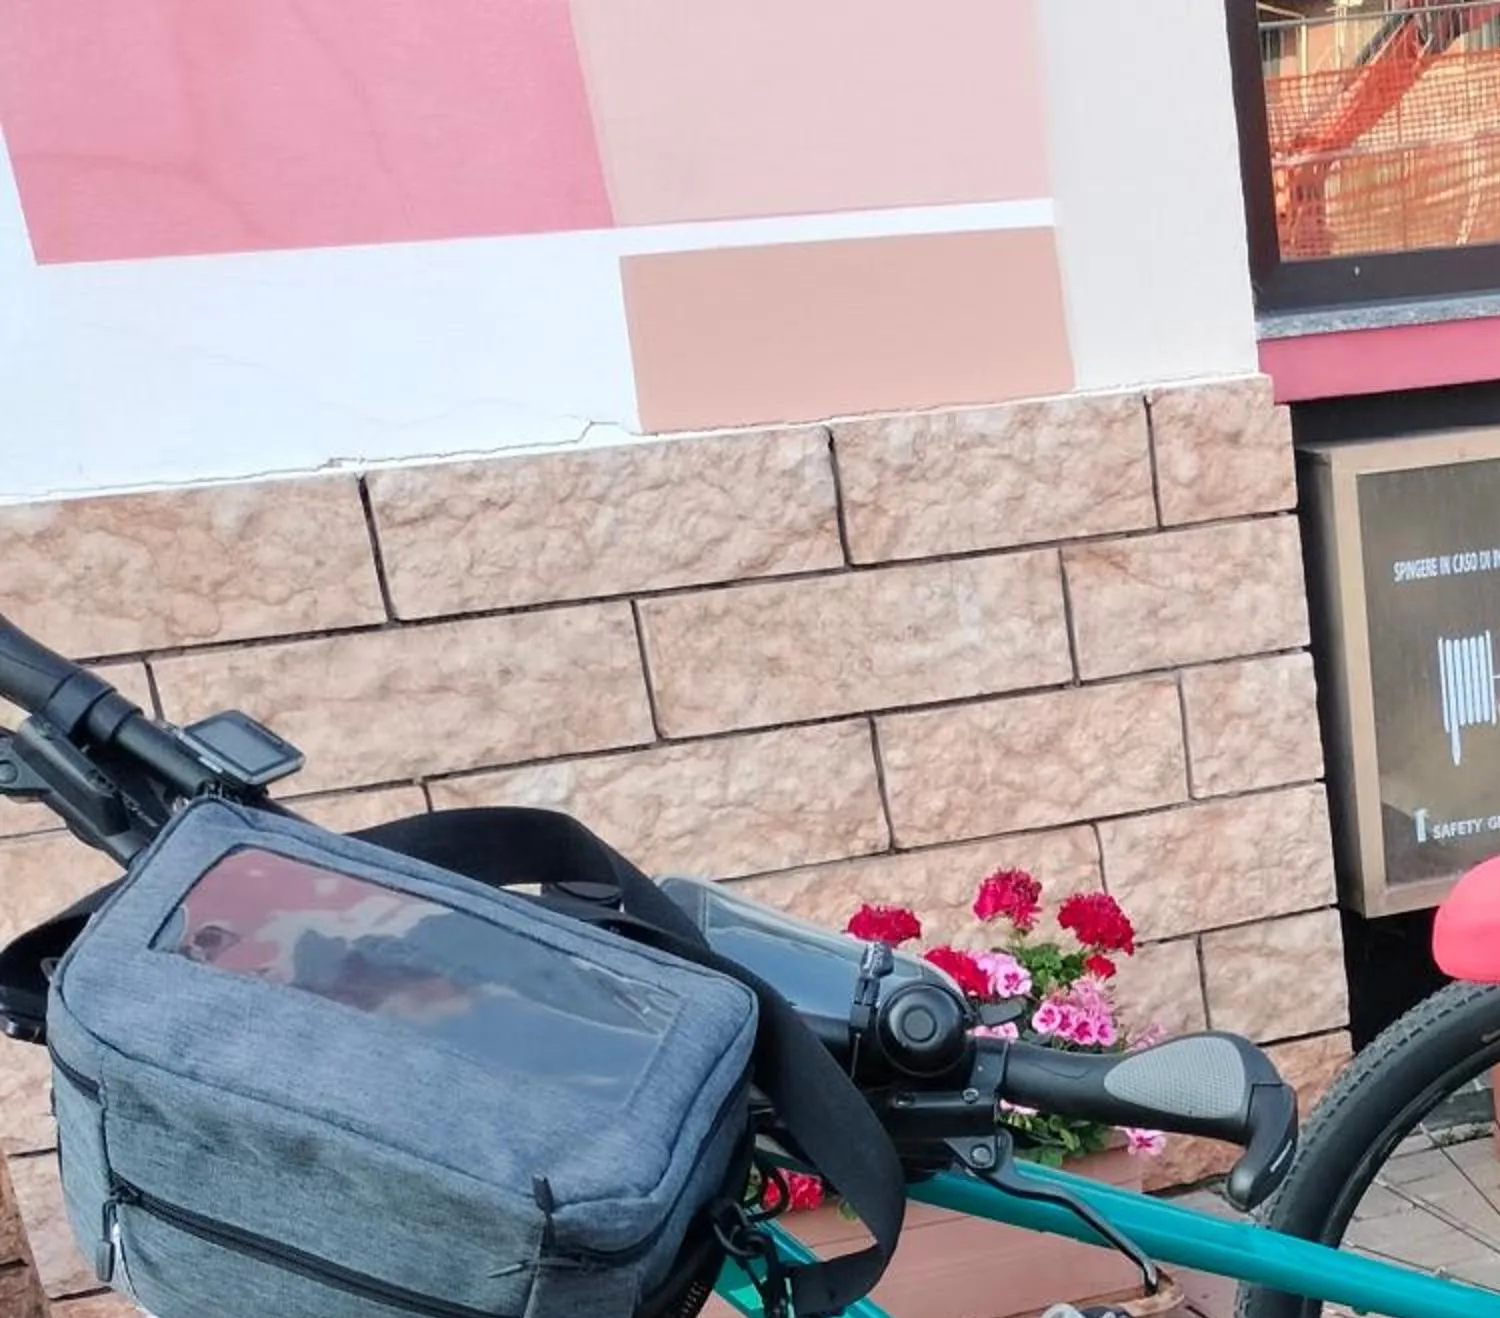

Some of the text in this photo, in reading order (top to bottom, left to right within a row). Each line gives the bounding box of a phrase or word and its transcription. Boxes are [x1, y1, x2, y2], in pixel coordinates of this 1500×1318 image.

[1393, 557, 1438, 582] SPINGERE
[1440, 556, 1451, 575] IN
[1452, 552, 1478, 573] CASO
[1479, 550, 1491, 570] DI
[1432, 817, 1483, 839] SAFETY
